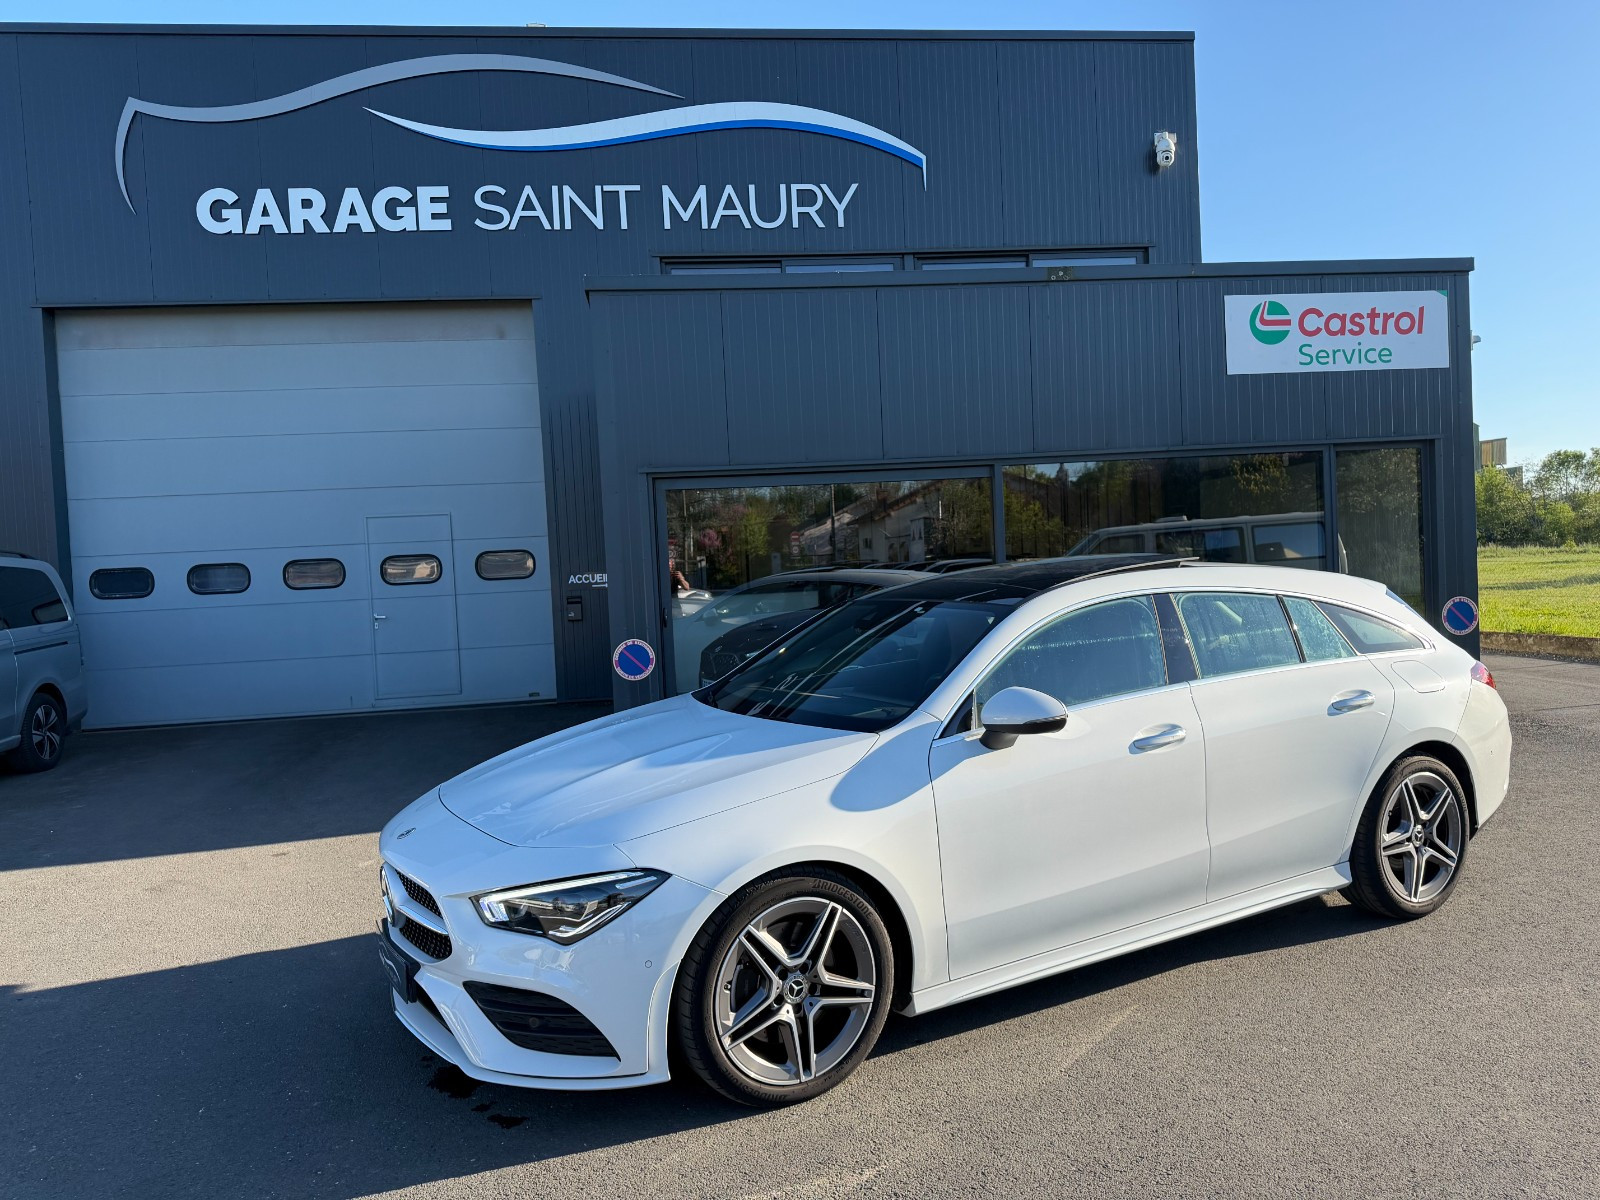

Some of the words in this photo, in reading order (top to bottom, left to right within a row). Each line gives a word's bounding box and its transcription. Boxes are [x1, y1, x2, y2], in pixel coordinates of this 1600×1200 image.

[195, 185, 453, 236] GARAGE
[473, 184, 641, 231] SAINT
[661, 182, 859, 230] MAURY
[1297, 305, 1425, 338] Castrol
[1298, 341, 1393, 366] Service
[811, 879, 873, 920] BRIDGESTONE
